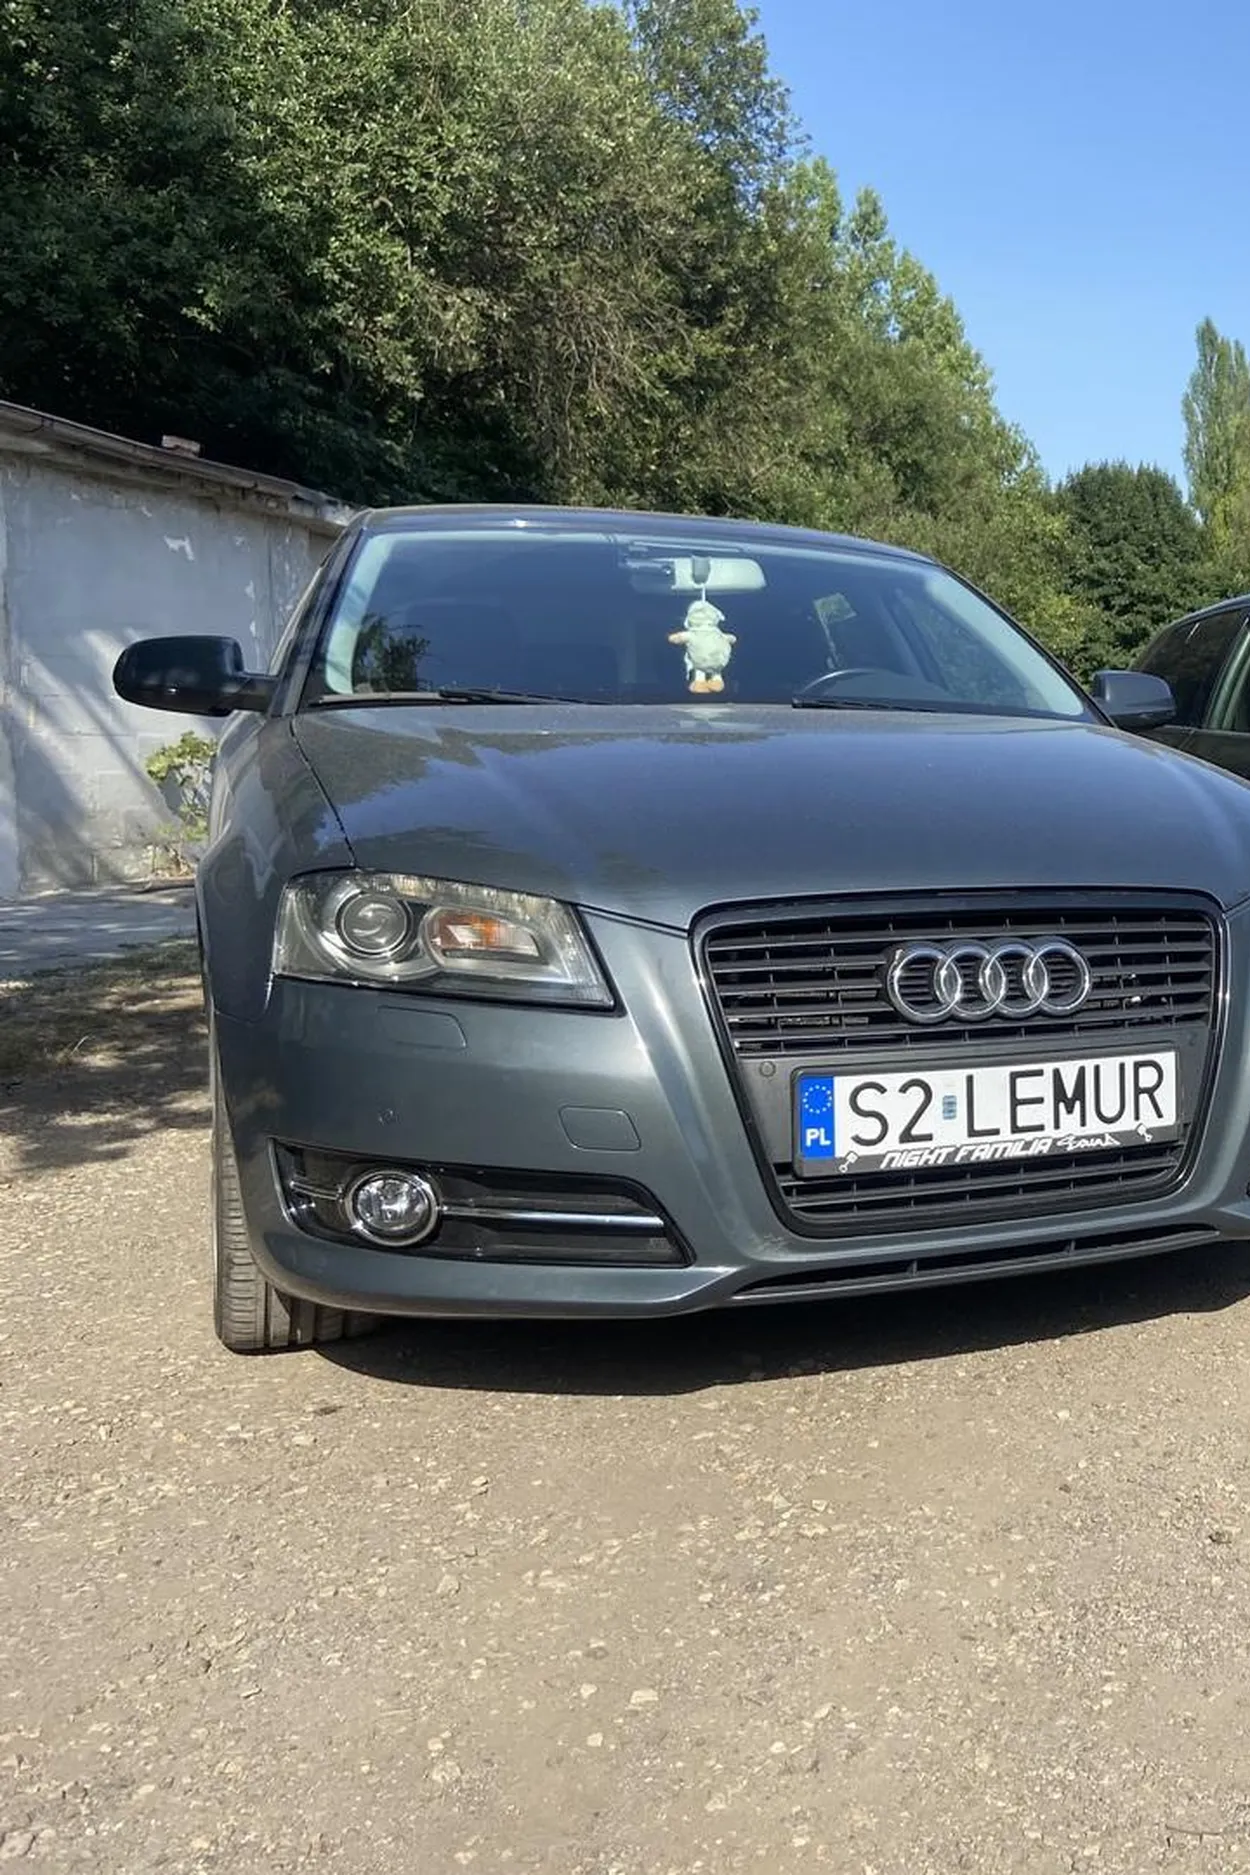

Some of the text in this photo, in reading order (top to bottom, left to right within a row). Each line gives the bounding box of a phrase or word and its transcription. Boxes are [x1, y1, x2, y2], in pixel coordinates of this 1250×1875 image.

[848, 1059, 1164, 1147] S2 LEMUR
[806, 1127, 831, 1147] PL
[880, 1146, 956, 1169] NIGHT
[955, 1137, 1053, 1163] FAMILIA
